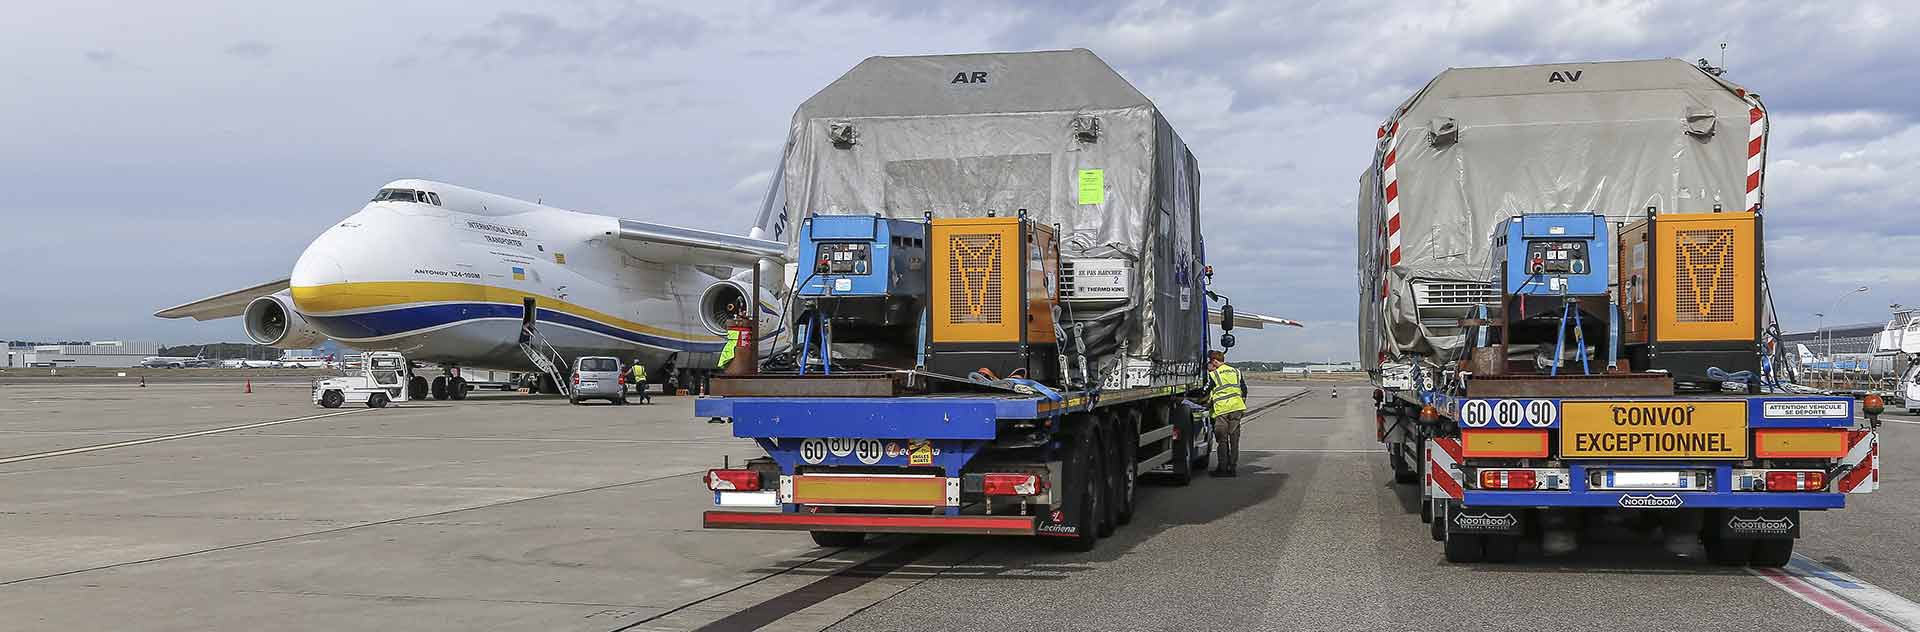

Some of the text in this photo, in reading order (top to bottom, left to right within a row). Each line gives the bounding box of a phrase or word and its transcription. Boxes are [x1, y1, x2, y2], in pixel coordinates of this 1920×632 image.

[951, 71, 988, 84] AR
[1549, 70, 1583, 83] AV
[466, 221, 528, 237] INTERNATIONAL CARGO
[484, 235, 521, 246] TRANSPORTER
[450, 271, 481, 279] 124-100M
[1113, 275, 1119, 285] 2
[1467, 401, 1486, 425] 60
[1499, 401, 1518, 425] 80
[1531, 401, 1551, 425] 90
[1614, 405, 1693, 427] CONVOI
[804, 440, 824, 460] 60
[859, 440, 879, 460] 90
[1575, 432, 1732, 452] EXCEPTIONNEL
[1038, 520, 1076, 533] Leciñena
